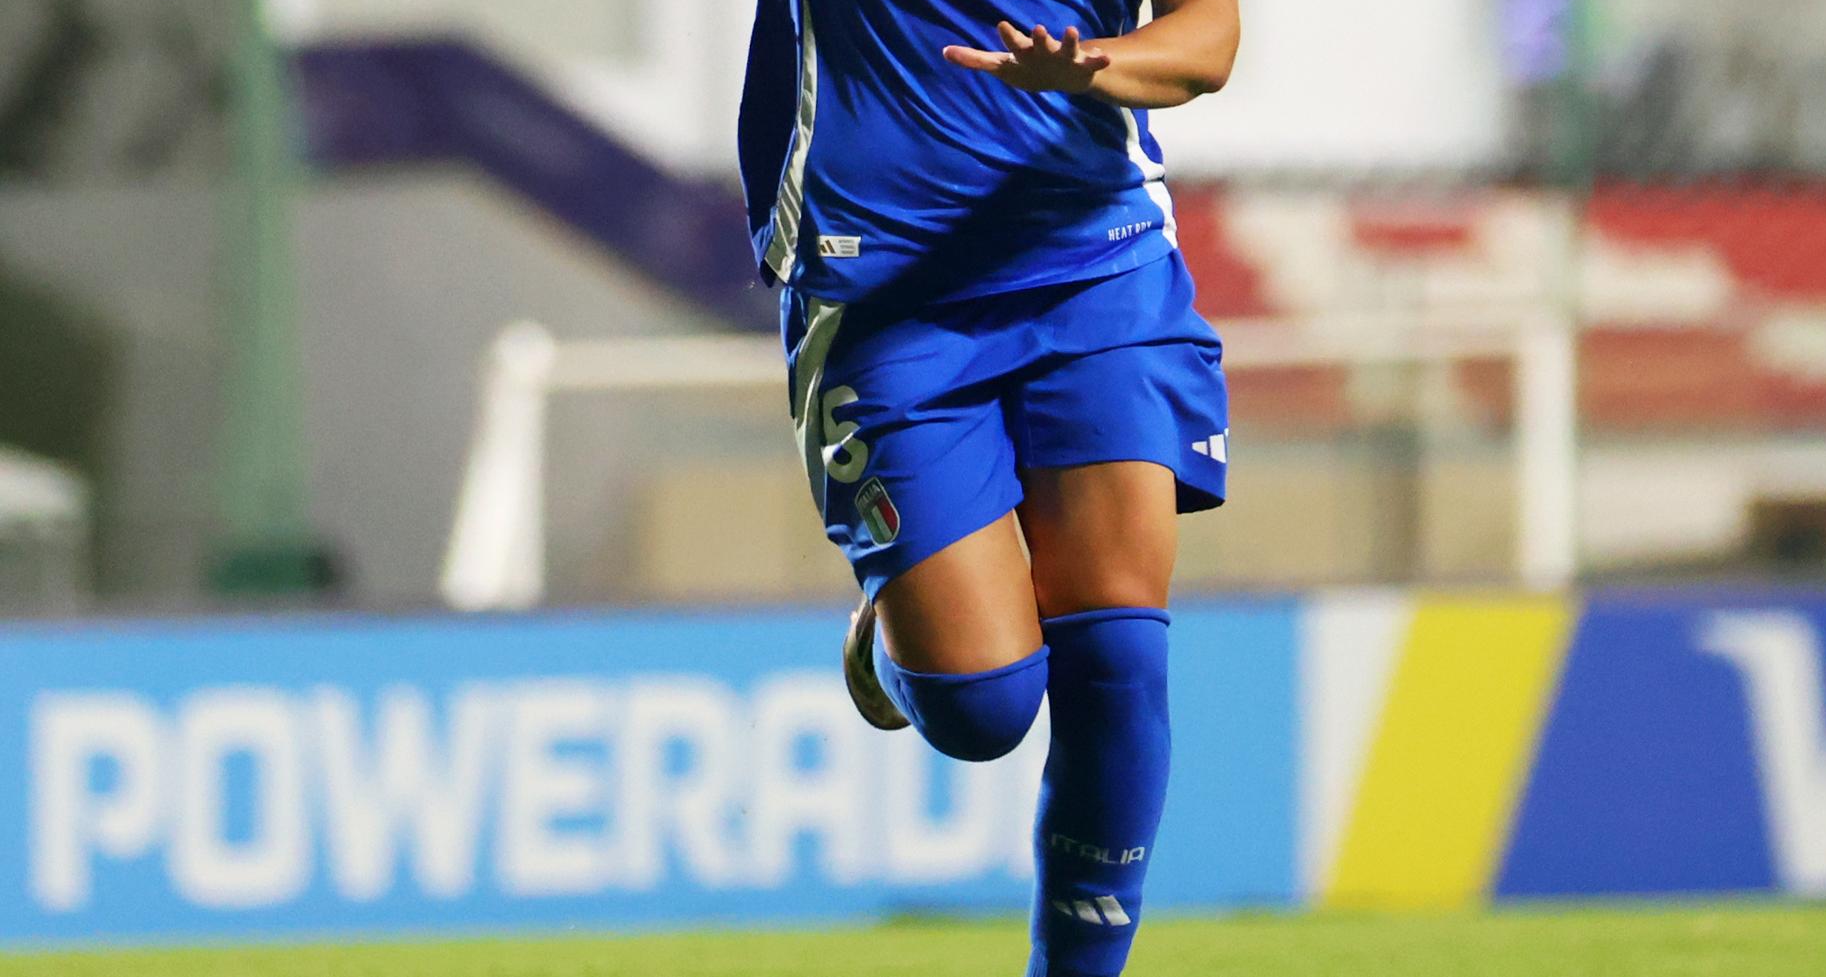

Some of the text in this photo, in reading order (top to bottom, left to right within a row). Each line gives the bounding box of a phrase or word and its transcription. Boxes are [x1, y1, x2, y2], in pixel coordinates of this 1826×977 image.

[1108, 224, 1133, 241] HEAT
[821, 385, 869, 484] 6
[30, 672, 1046, 910] POWERAD
[1052, 833, 1146, 865] ITALIA
